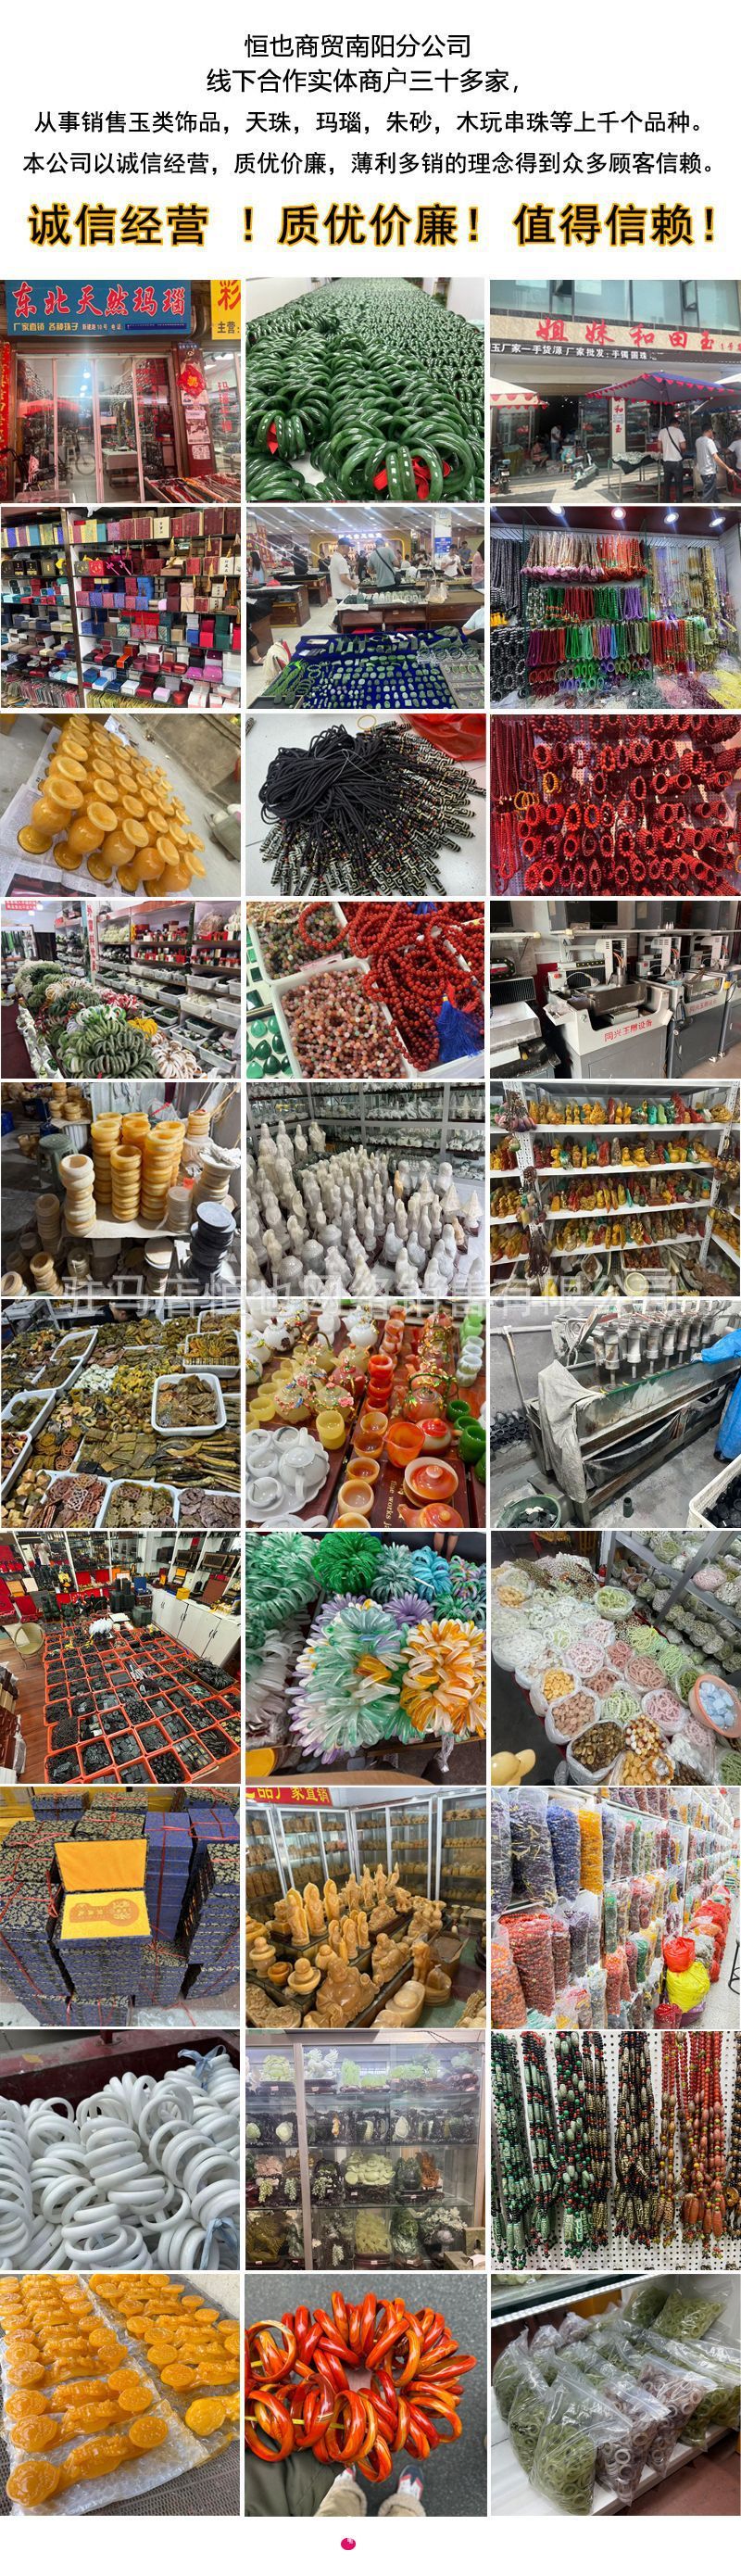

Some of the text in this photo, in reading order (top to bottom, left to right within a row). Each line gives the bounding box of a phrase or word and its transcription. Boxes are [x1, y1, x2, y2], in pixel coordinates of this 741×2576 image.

[12, 282, 185, 318] 东北天然玛瑙
[536, 318, 714, 348] 姐妹和田玉
